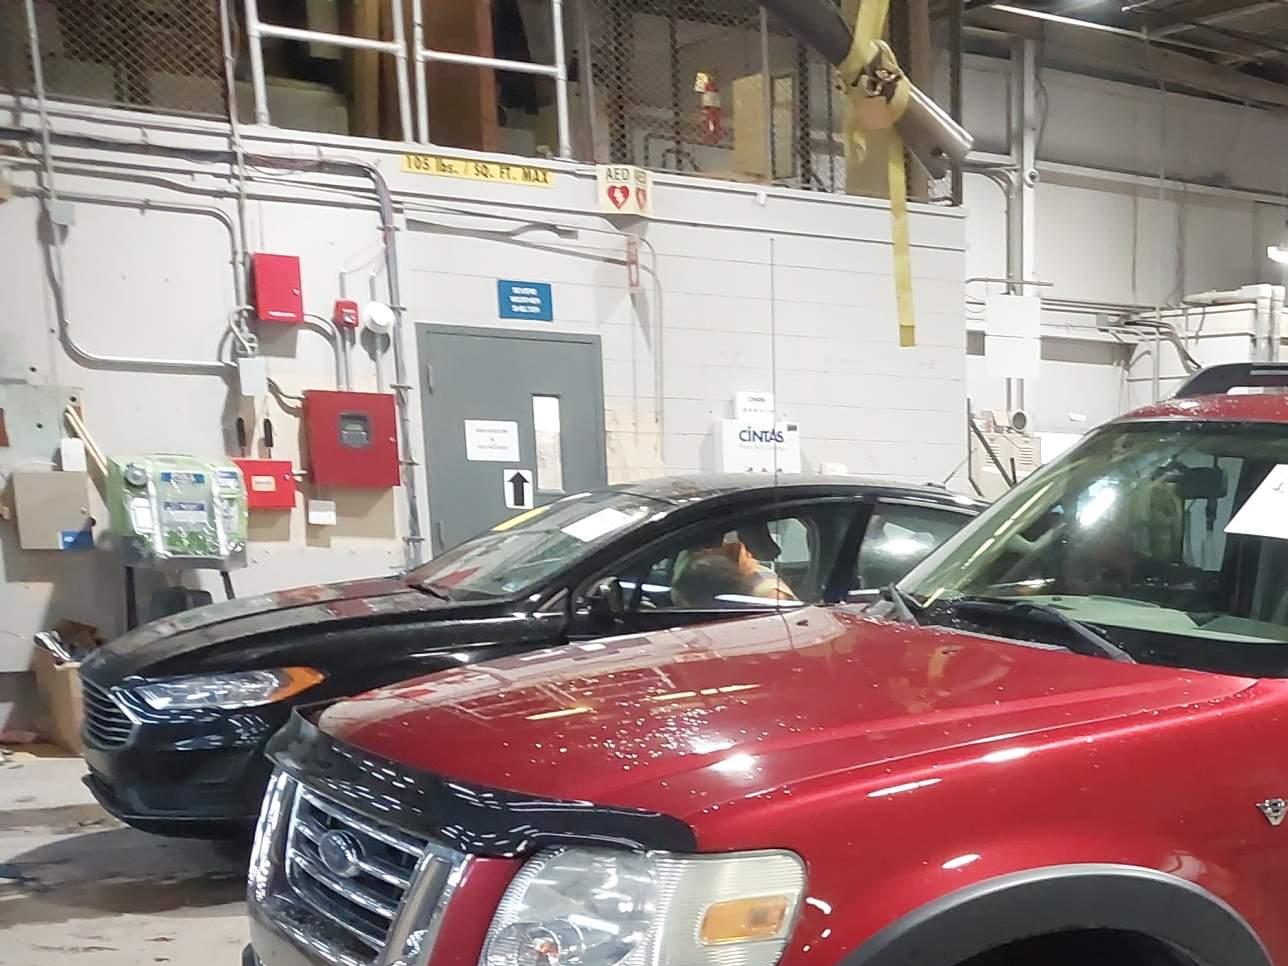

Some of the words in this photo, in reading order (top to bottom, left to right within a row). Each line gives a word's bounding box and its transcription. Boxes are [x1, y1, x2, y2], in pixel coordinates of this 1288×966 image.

[473, 162, 494, 178] SQ.
[499, 165, 517, 181] FT.
[522, 167, 550, 185] MAX
[606, 167, 630, 181] AED
